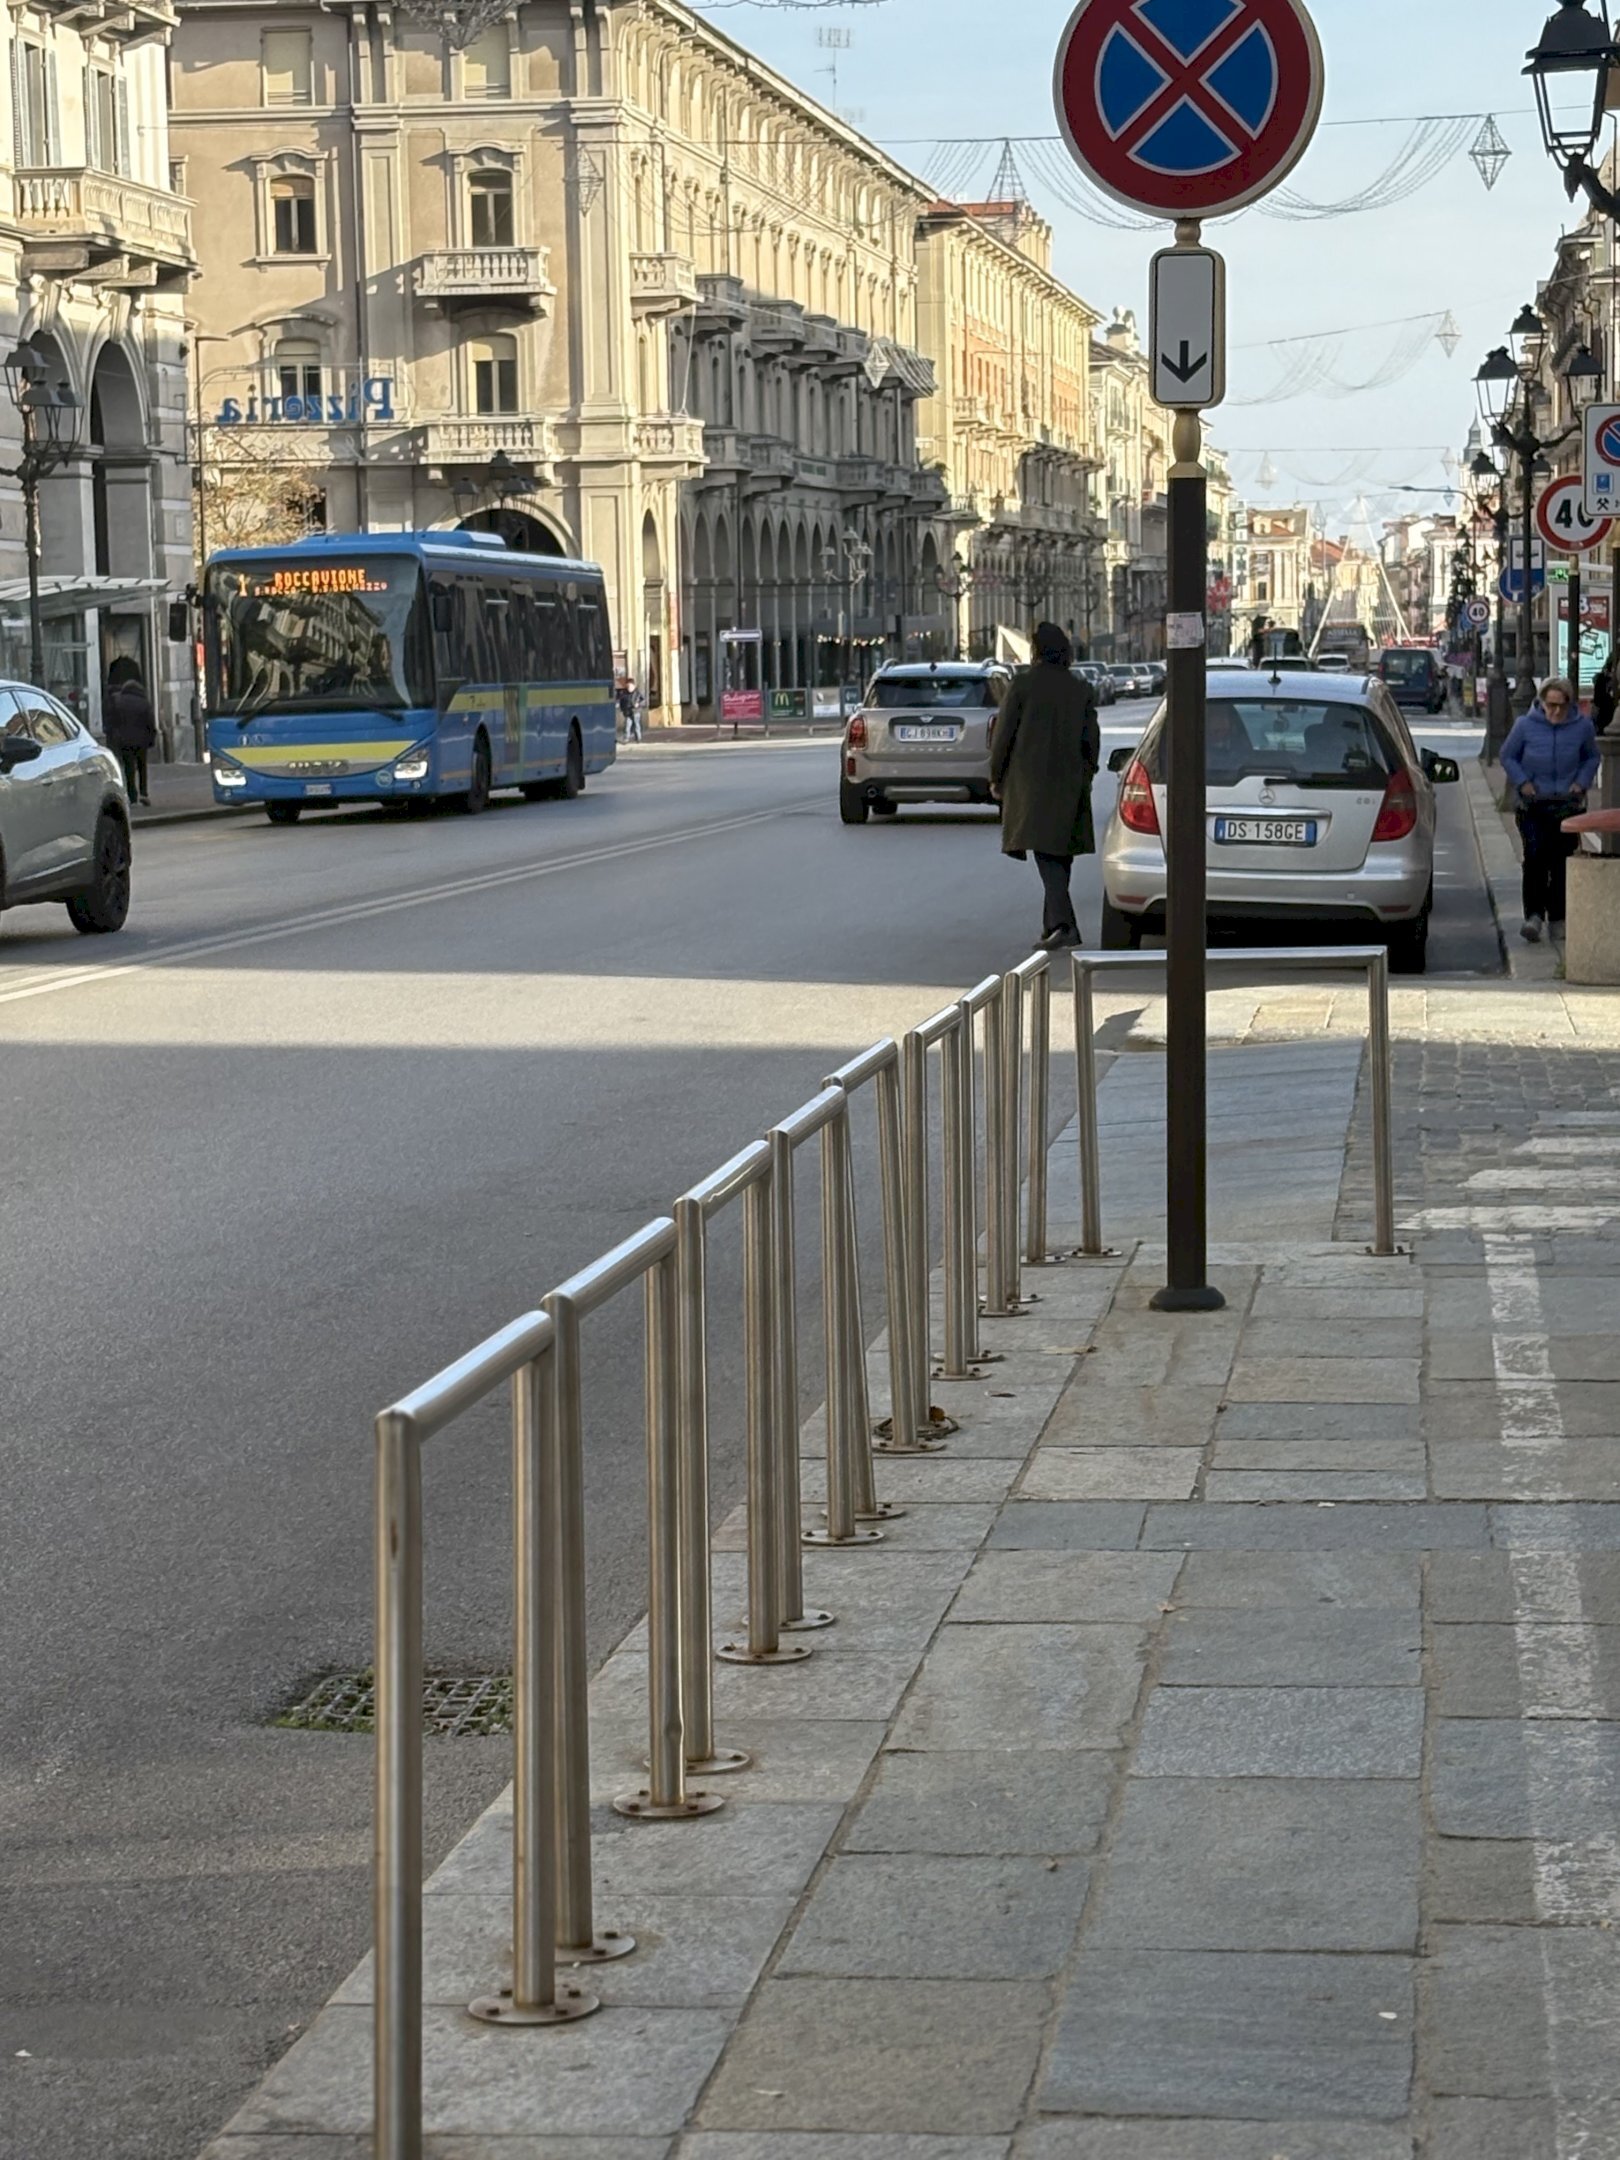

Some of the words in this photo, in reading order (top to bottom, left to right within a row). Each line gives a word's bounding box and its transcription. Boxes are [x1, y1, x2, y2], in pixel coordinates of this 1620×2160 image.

[274, 569, 366, 589] ROCCAVIONE
[1471, 606, 1485, 616] 40
[1228, 821, 1248, 838] DS
[1254, 822, 1304, 840] 158GE
